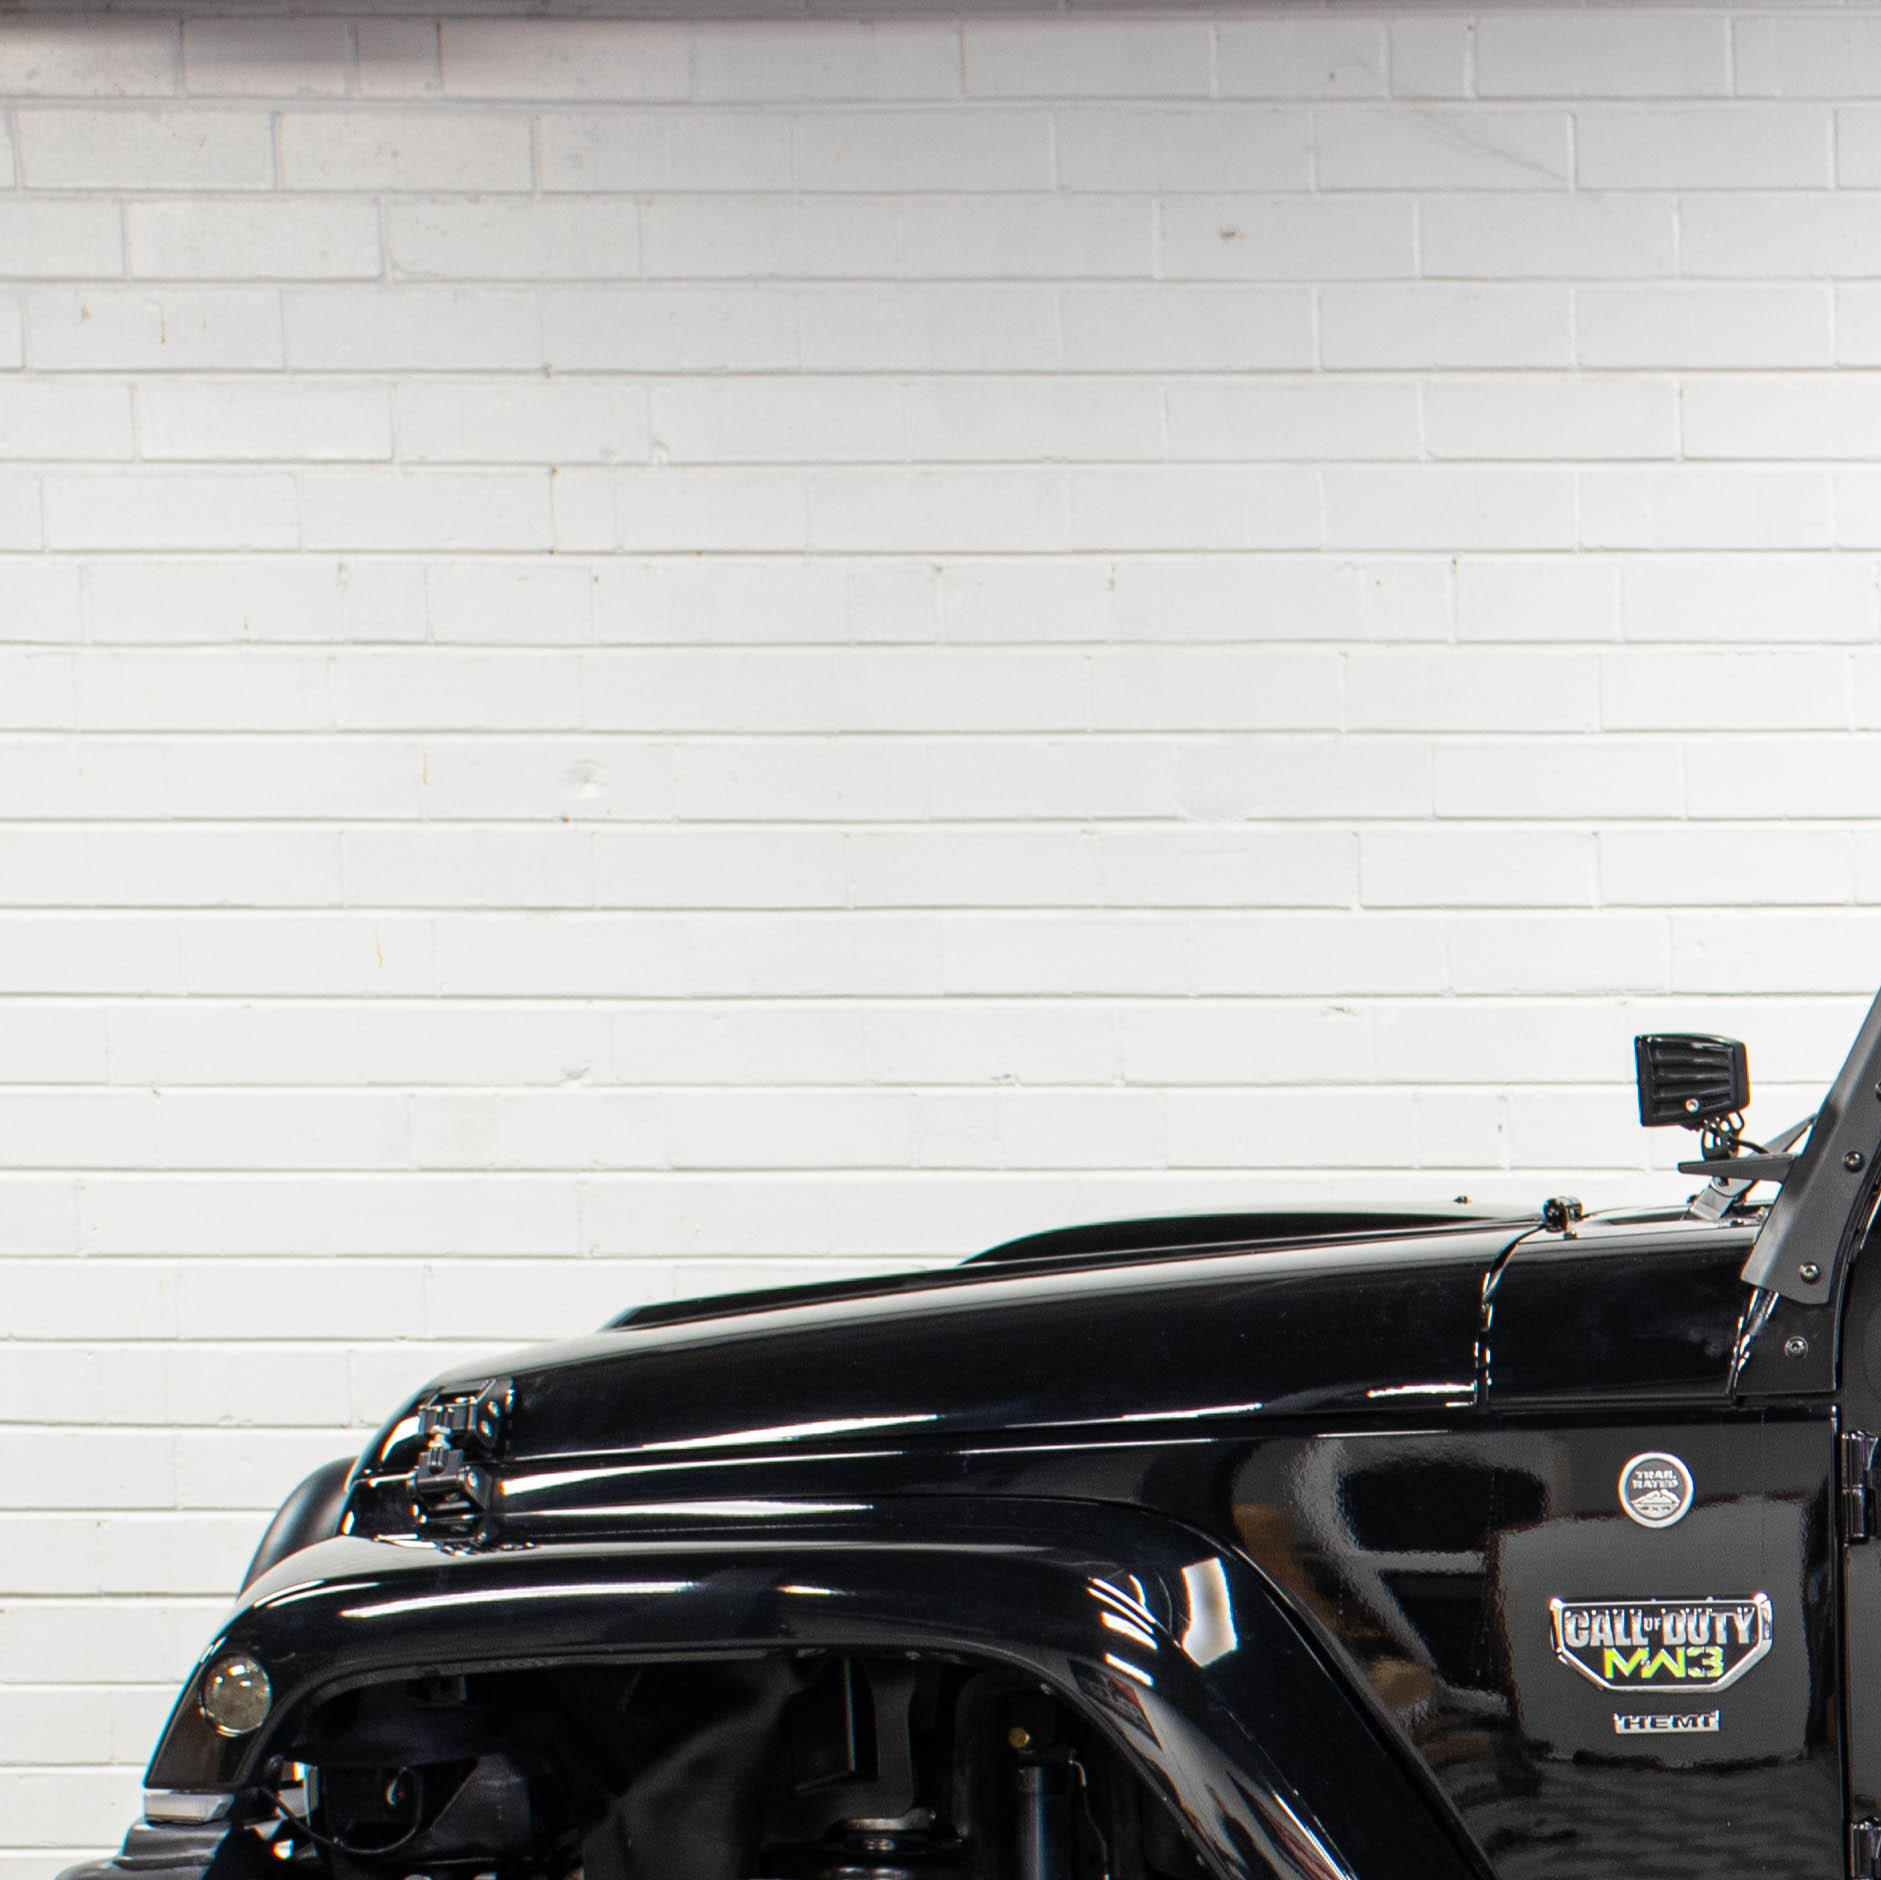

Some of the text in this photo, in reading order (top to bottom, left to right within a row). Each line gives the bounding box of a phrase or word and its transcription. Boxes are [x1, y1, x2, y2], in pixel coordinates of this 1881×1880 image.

[1634, 1470, 1677, 1479] TRAIL
[1631, 1479, 1679, 1489] RATED
[1563, 1606, 1754, 1647] CALL OF DUTY
[1603, 1646, 1725, 1678] MW3
[1622, 1713, 1717, 1730] HEMI
